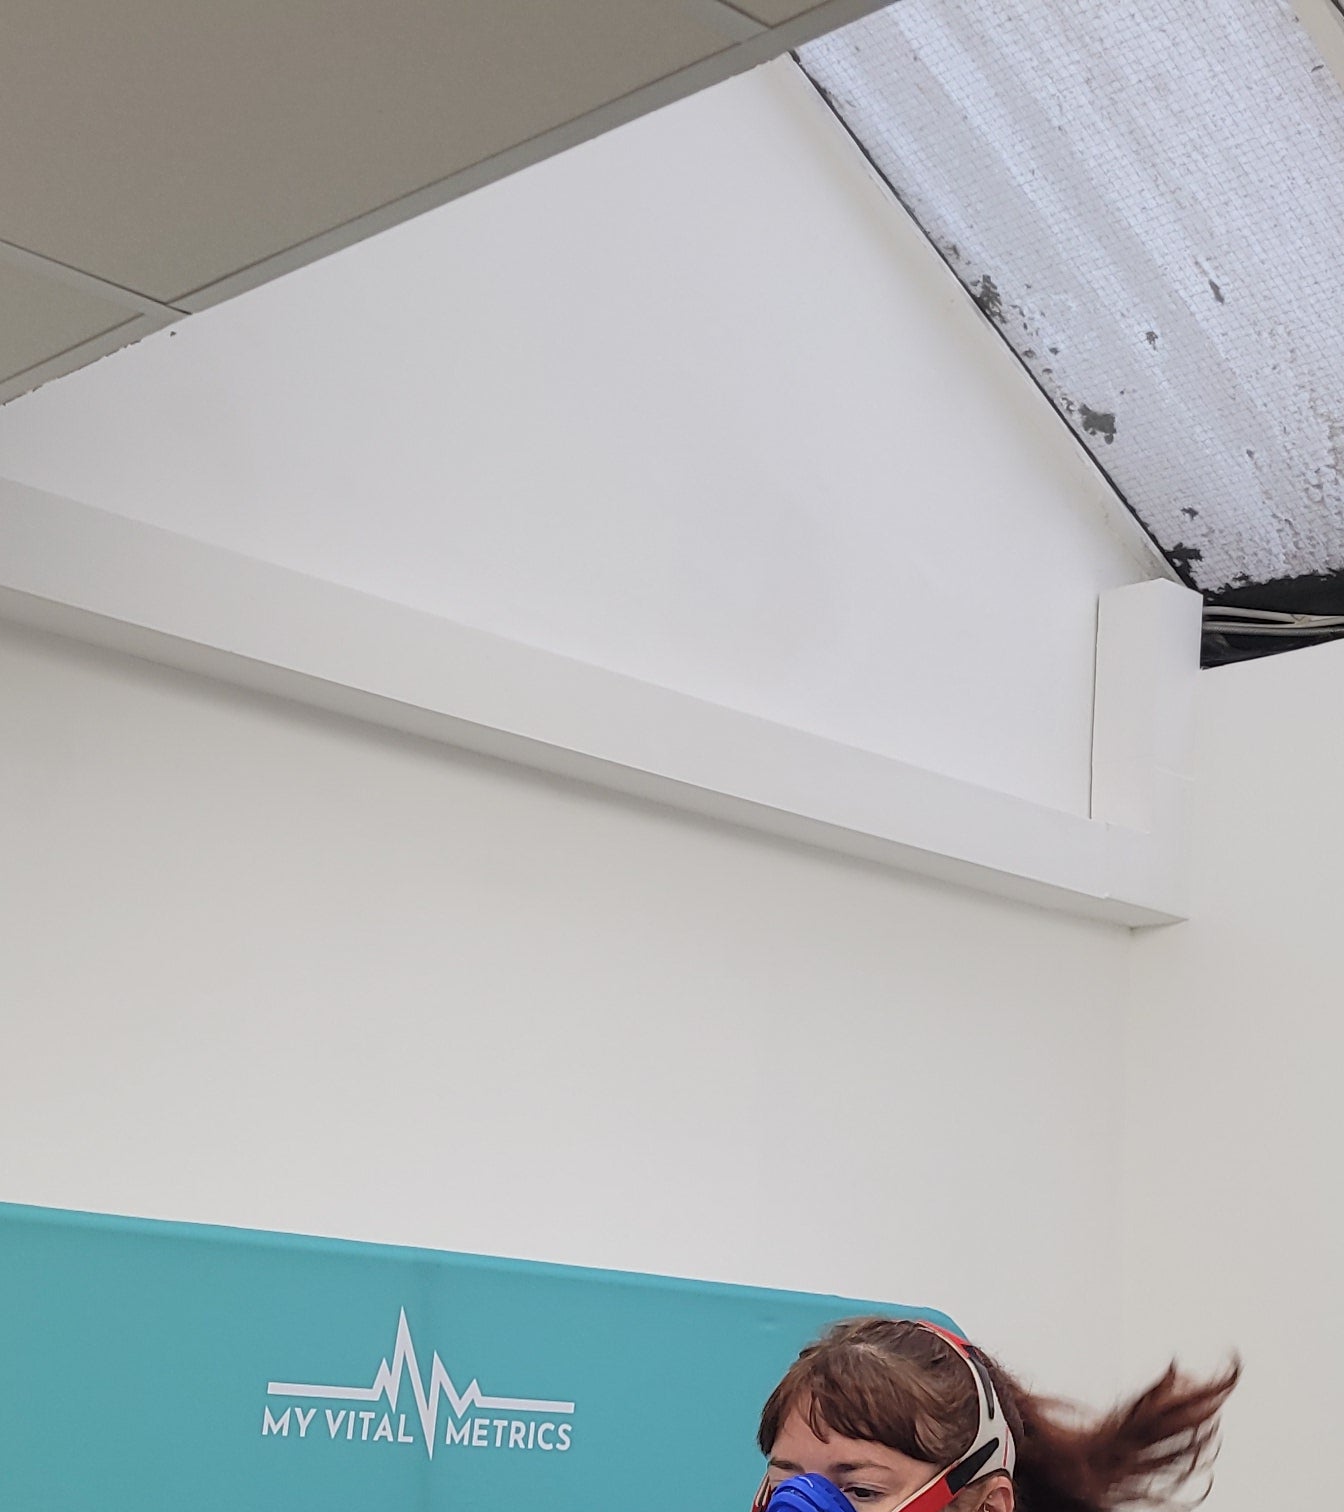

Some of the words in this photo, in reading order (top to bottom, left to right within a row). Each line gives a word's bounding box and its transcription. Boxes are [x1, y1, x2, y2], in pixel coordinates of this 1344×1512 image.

[261, 1405, 317, 1438] MY
[325, 1409, 414, 1443] VITAL
[445, 1416, 573, 1451] METRICS
